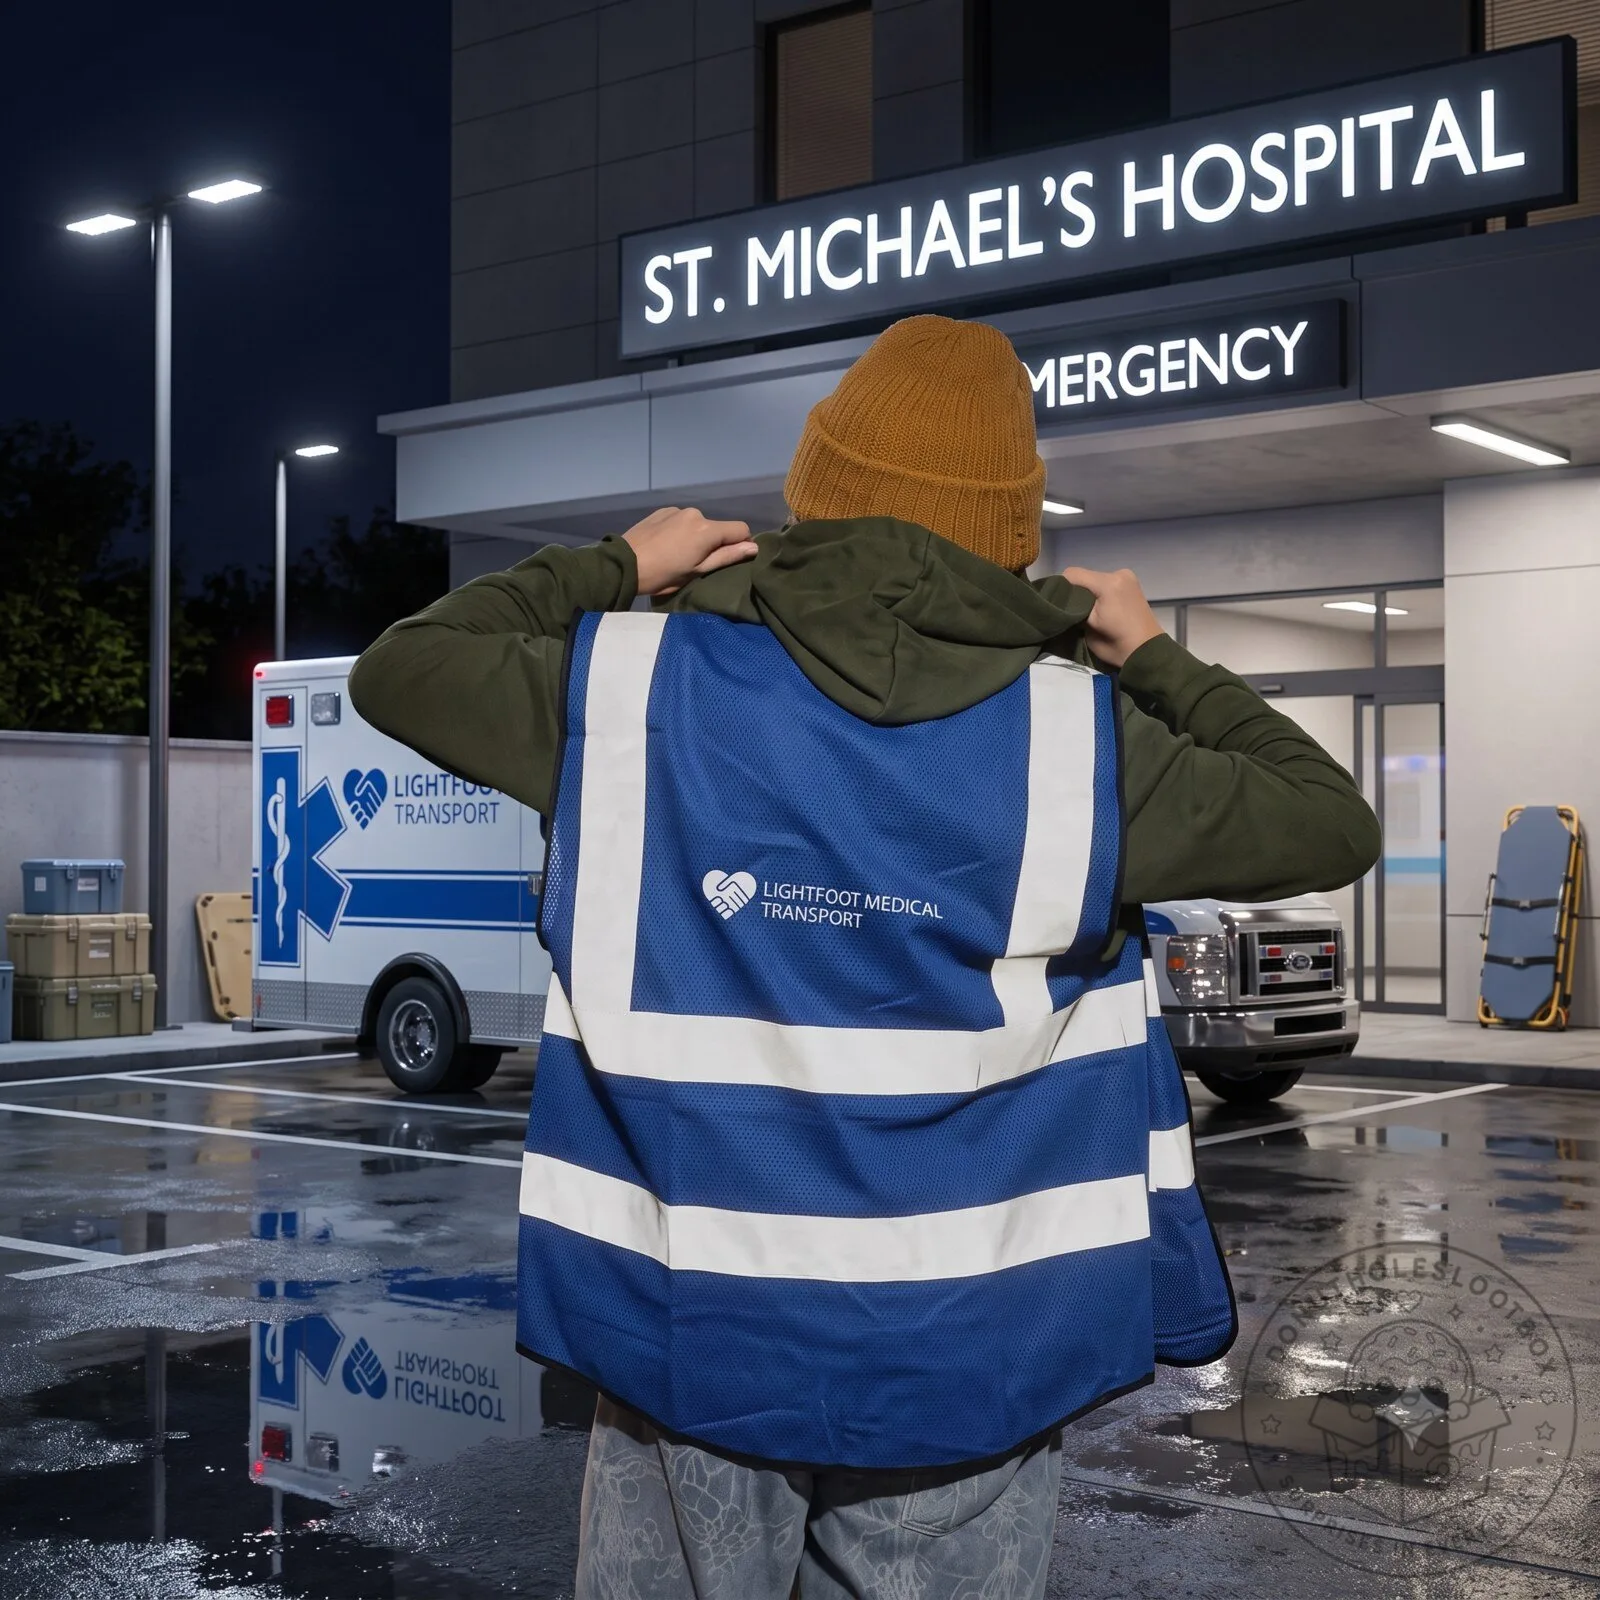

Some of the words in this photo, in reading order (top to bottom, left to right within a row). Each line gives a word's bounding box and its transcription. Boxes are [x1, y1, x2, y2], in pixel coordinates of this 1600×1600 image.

[643, 245, 725, 325] ST.
[746, 170, 1097, 307] MICHAEL'S
[1122, 88, 1526, 239] HOSPITAL
[1022, 321, 1309, 409] MERGENCY
[394, 773, 501, 798] LIGHTFO
[394, 802, 501, 825] TRANSPORT
[760, 901, 863, 929] TRANSPORT
[763, 881, 862, 907] LIGHTFOOT
[864, 894, 944, 919] MEDICAL
